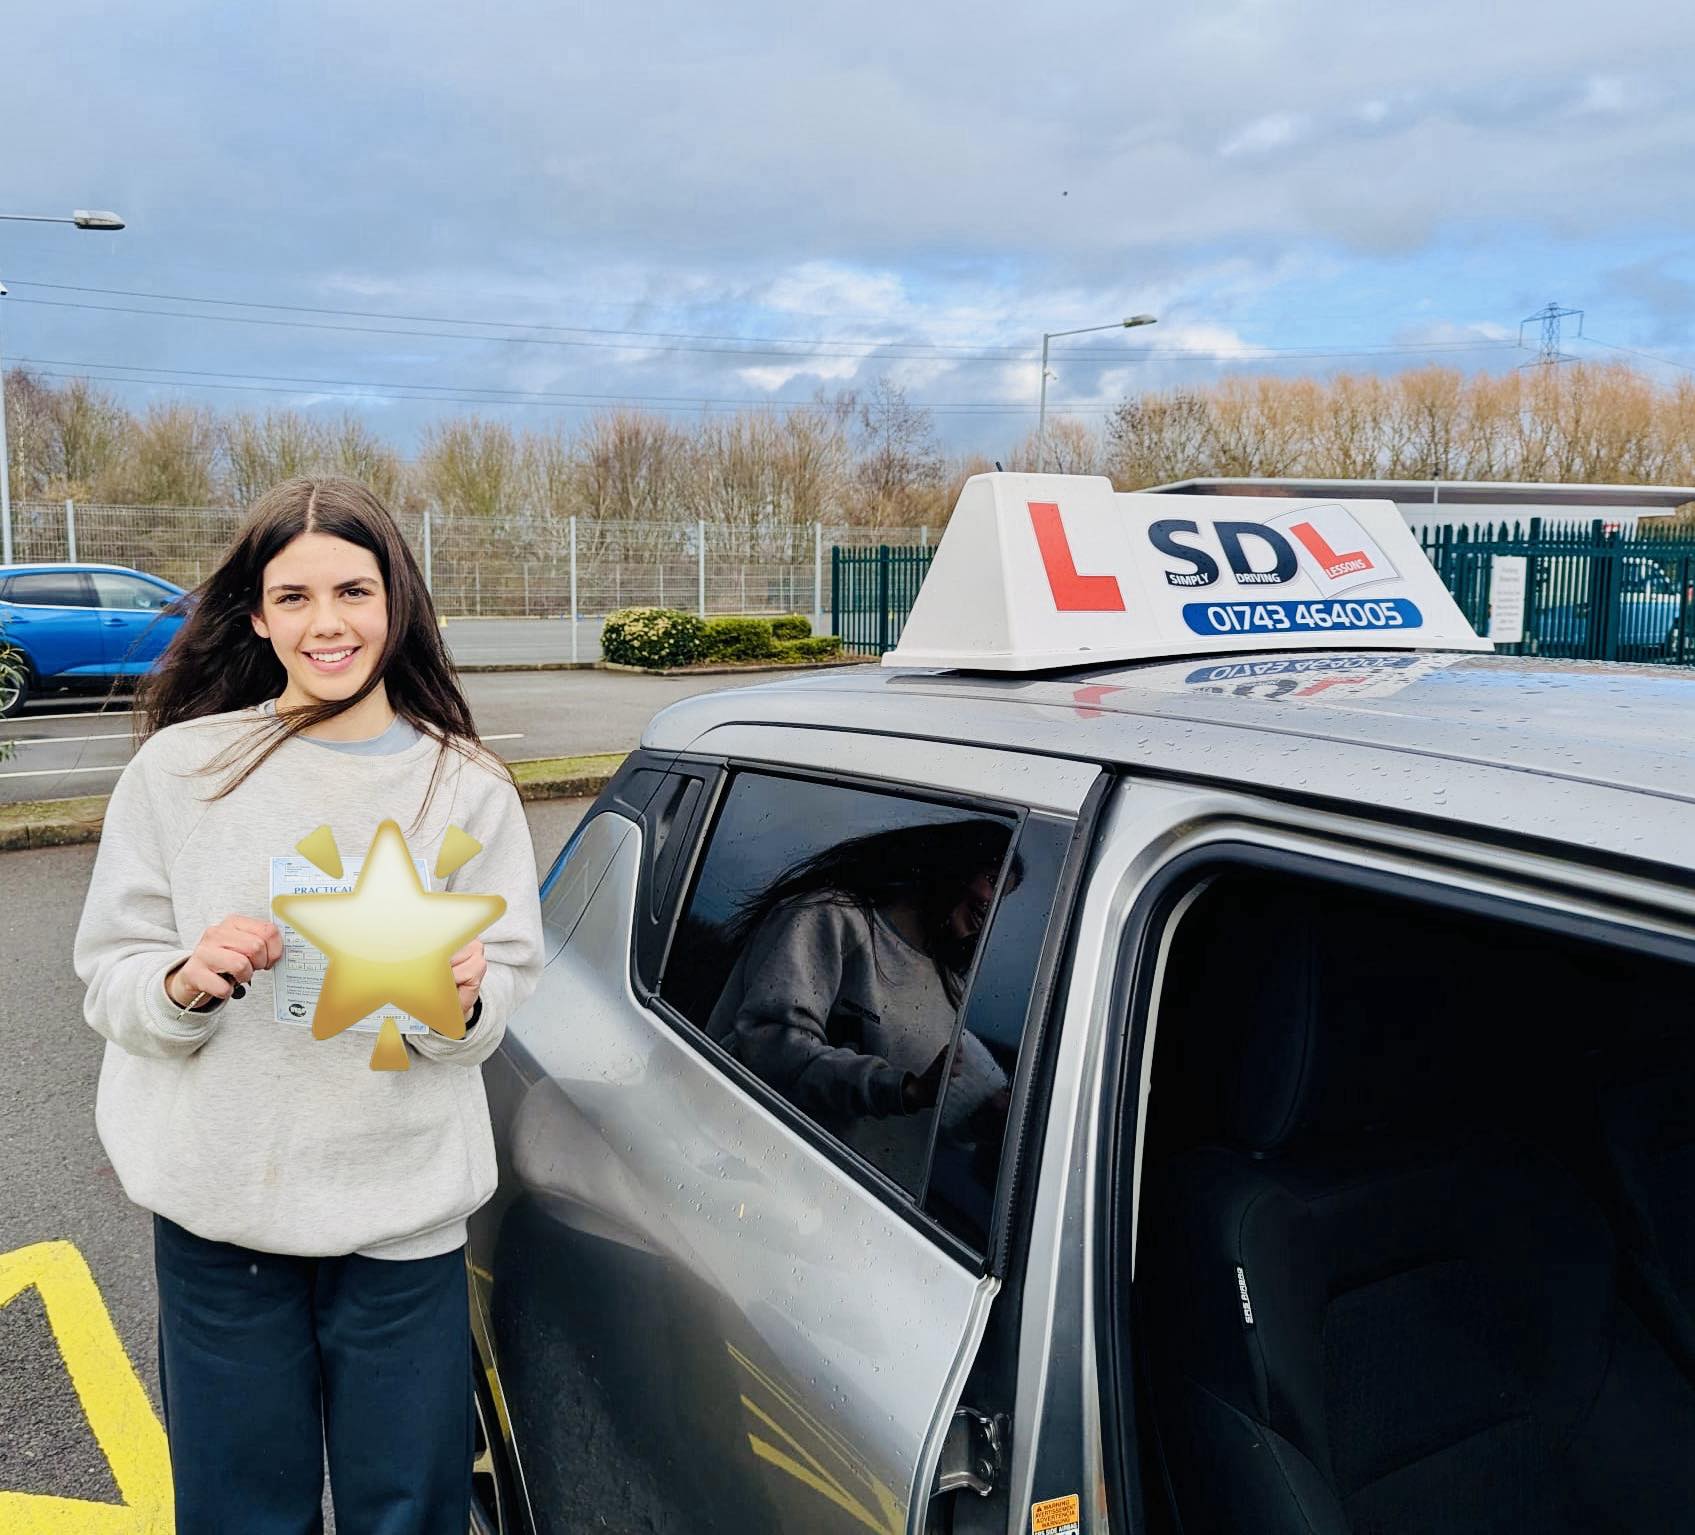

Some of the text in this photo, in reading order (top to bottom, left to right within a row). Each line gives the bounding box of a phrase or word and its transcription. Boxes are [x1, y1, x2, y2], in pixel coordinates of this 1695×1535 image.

[1027, 502, 1126, 613] L
[1168, 572, 1209, 586] SIMPLY
[1235, 572, 1281, 584] DRIVING
[1326, 559, 1367, 579] LESSONS
[1207, 601, 1404, 632] 01743 464005
